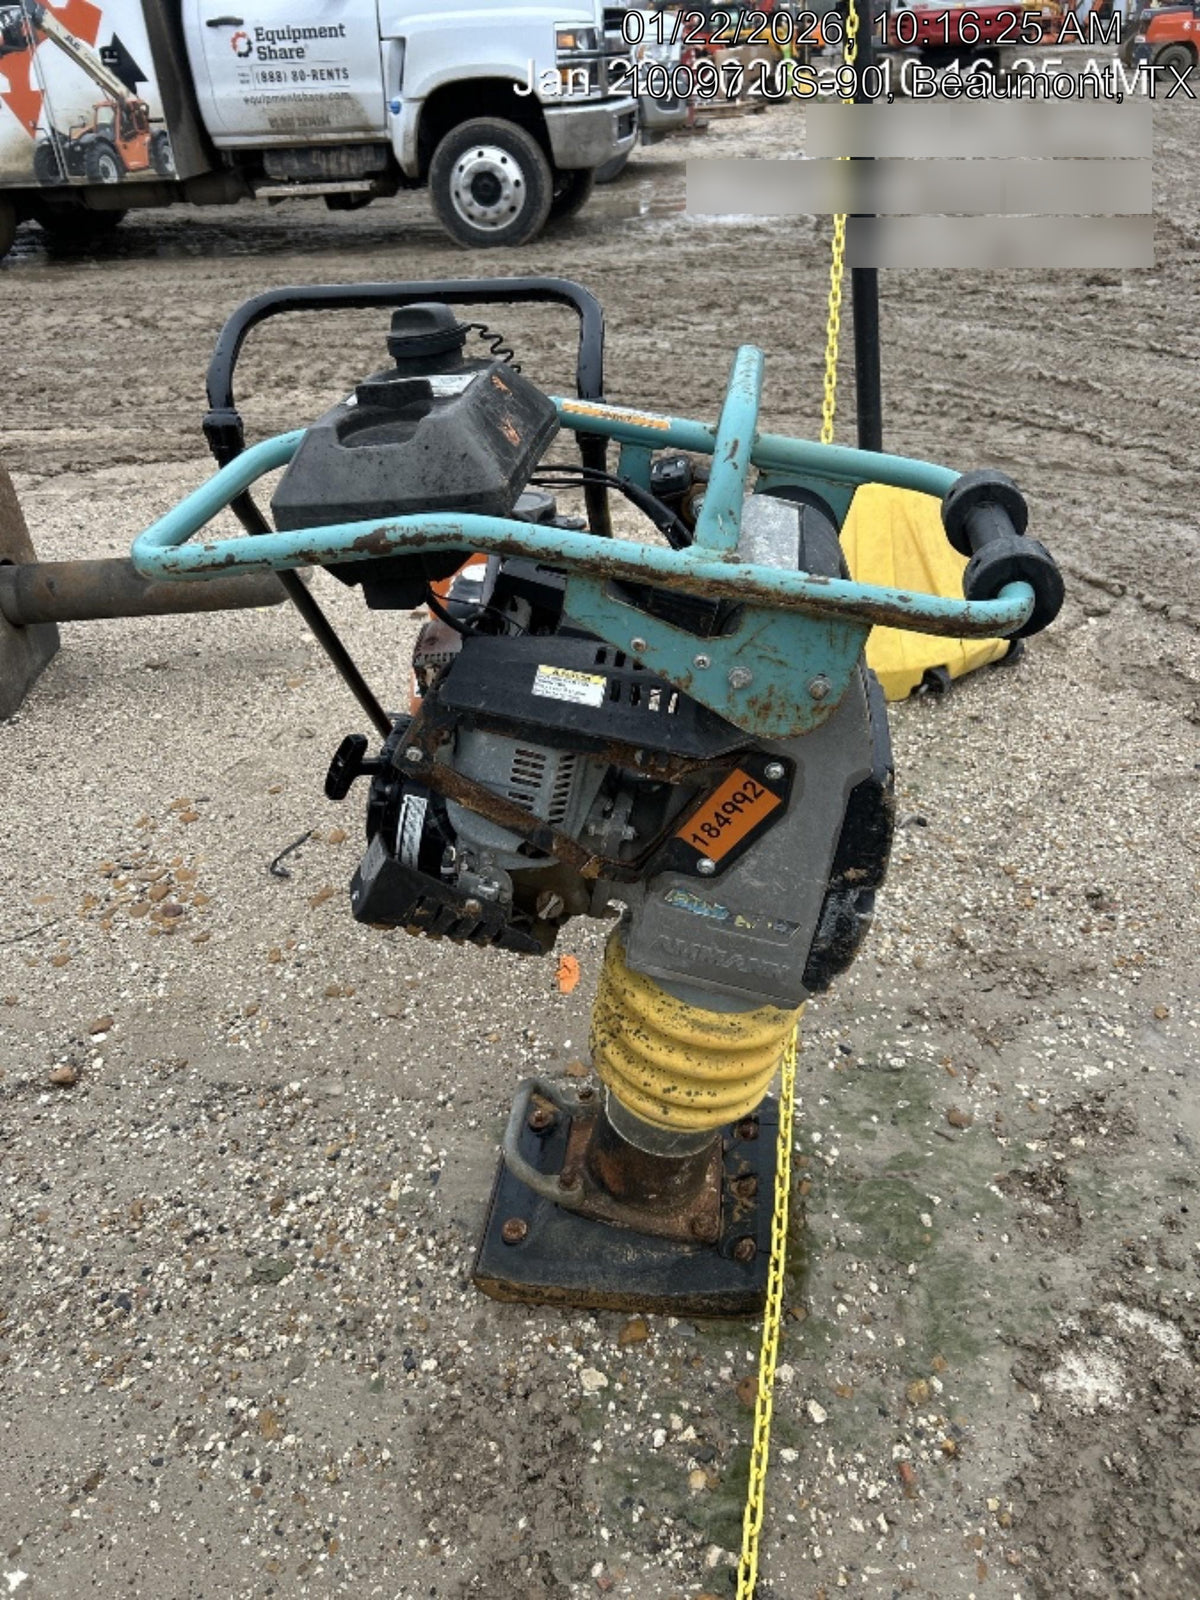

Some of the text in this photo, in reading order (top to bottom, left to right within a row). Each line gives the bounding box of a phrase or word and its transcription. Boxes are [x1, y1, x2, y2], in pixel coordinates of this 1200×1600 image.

[254, 23, 346, 44] Equipment
[257, 45, 305, 61] Share
[255, 70, 287, 84] (888)
[691, 780, 765, 847] 184992
